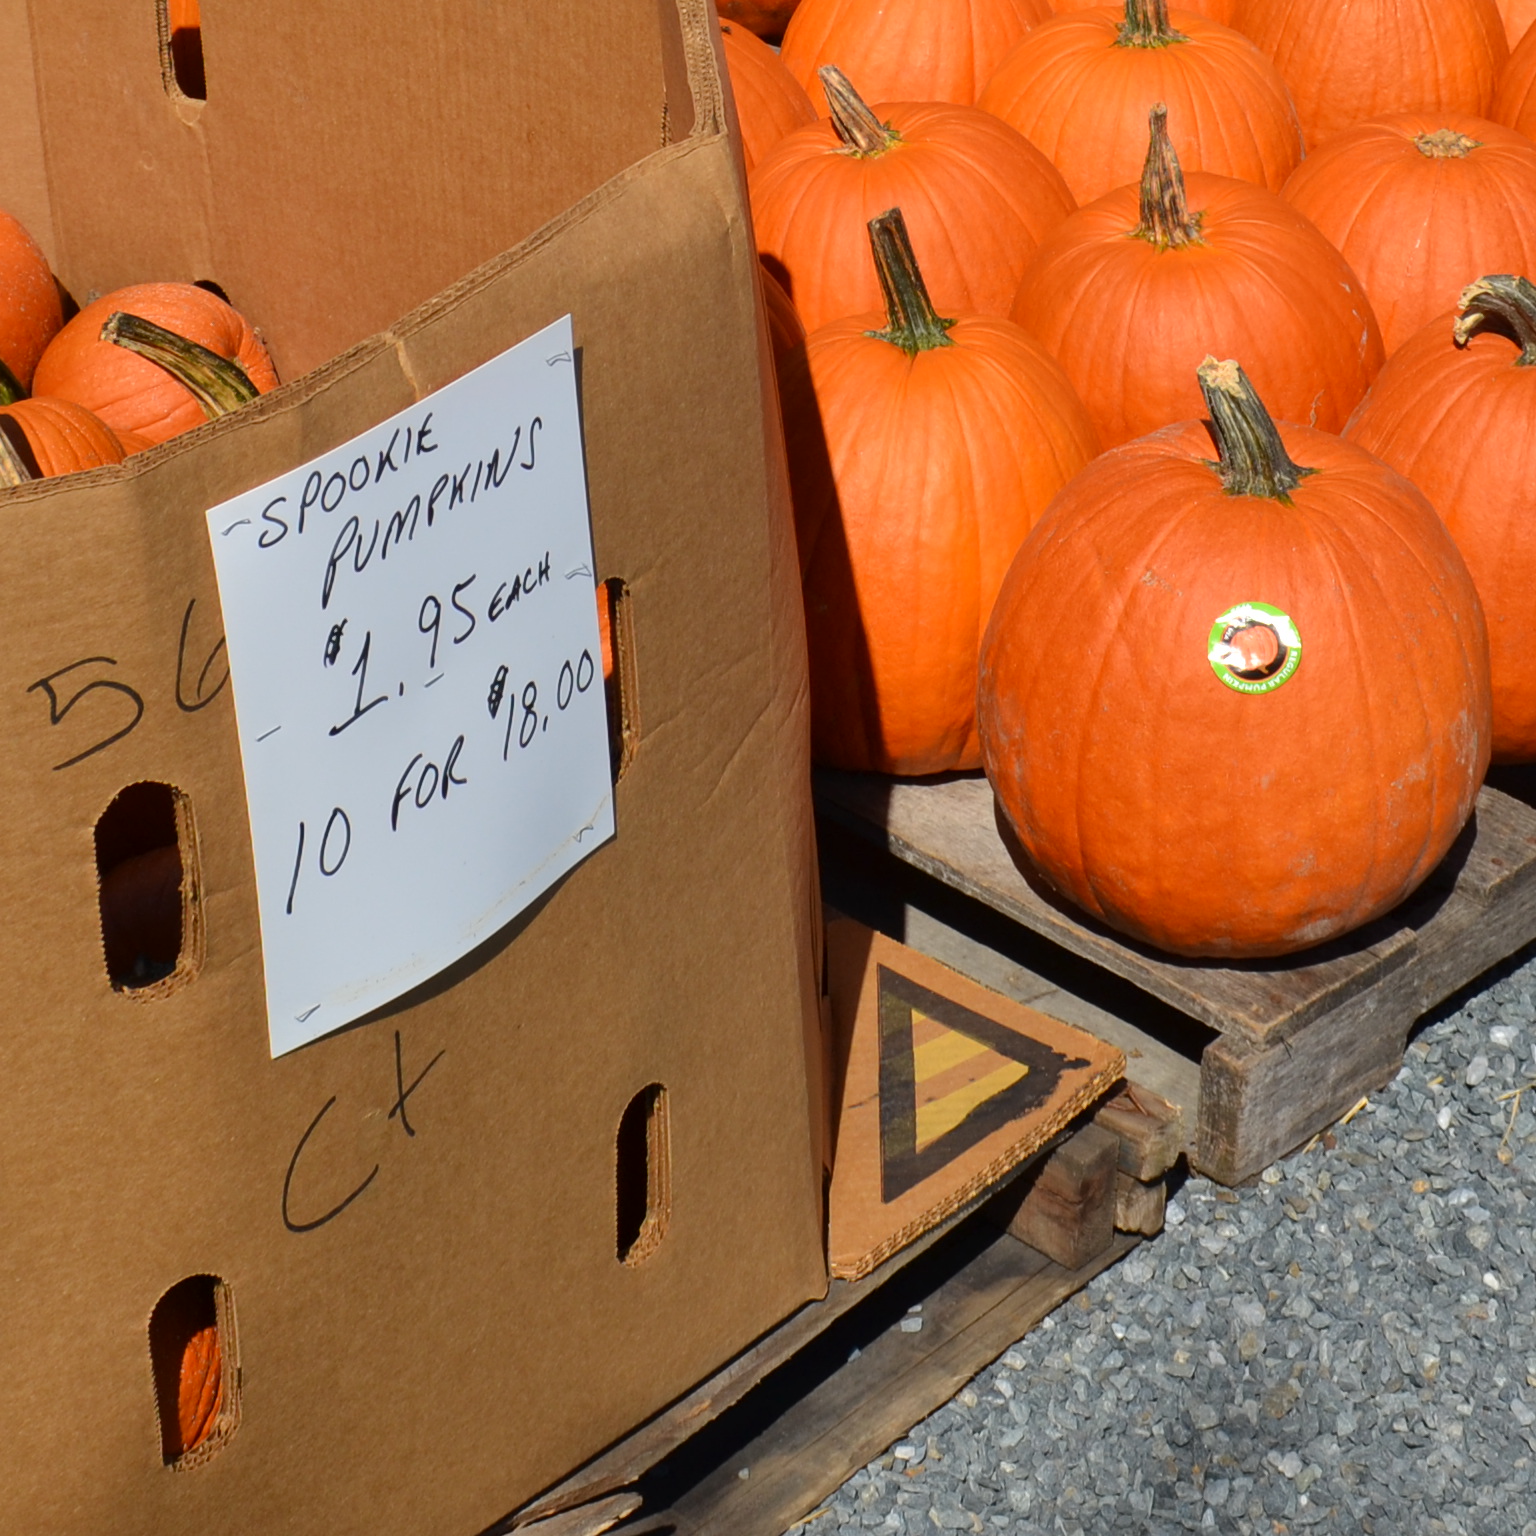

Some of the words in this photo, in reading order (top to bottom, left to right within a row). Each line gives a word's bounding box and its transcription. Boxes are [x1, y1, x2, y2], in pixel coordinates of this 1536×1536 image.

[256, 412, 441, 550] SPOOKIE
[320, 415, 544, 609] PUMPKINS
[487, 555, 551, 622] EACH
[1222, 672, 1268, 692] PUMPKIN
[1268, 650, 1298, 688] REGULAR
[286, 807, 351, 915] 10
[391, 735, 468, 831] FOR
[487, 649, 595, 761] $18.00
